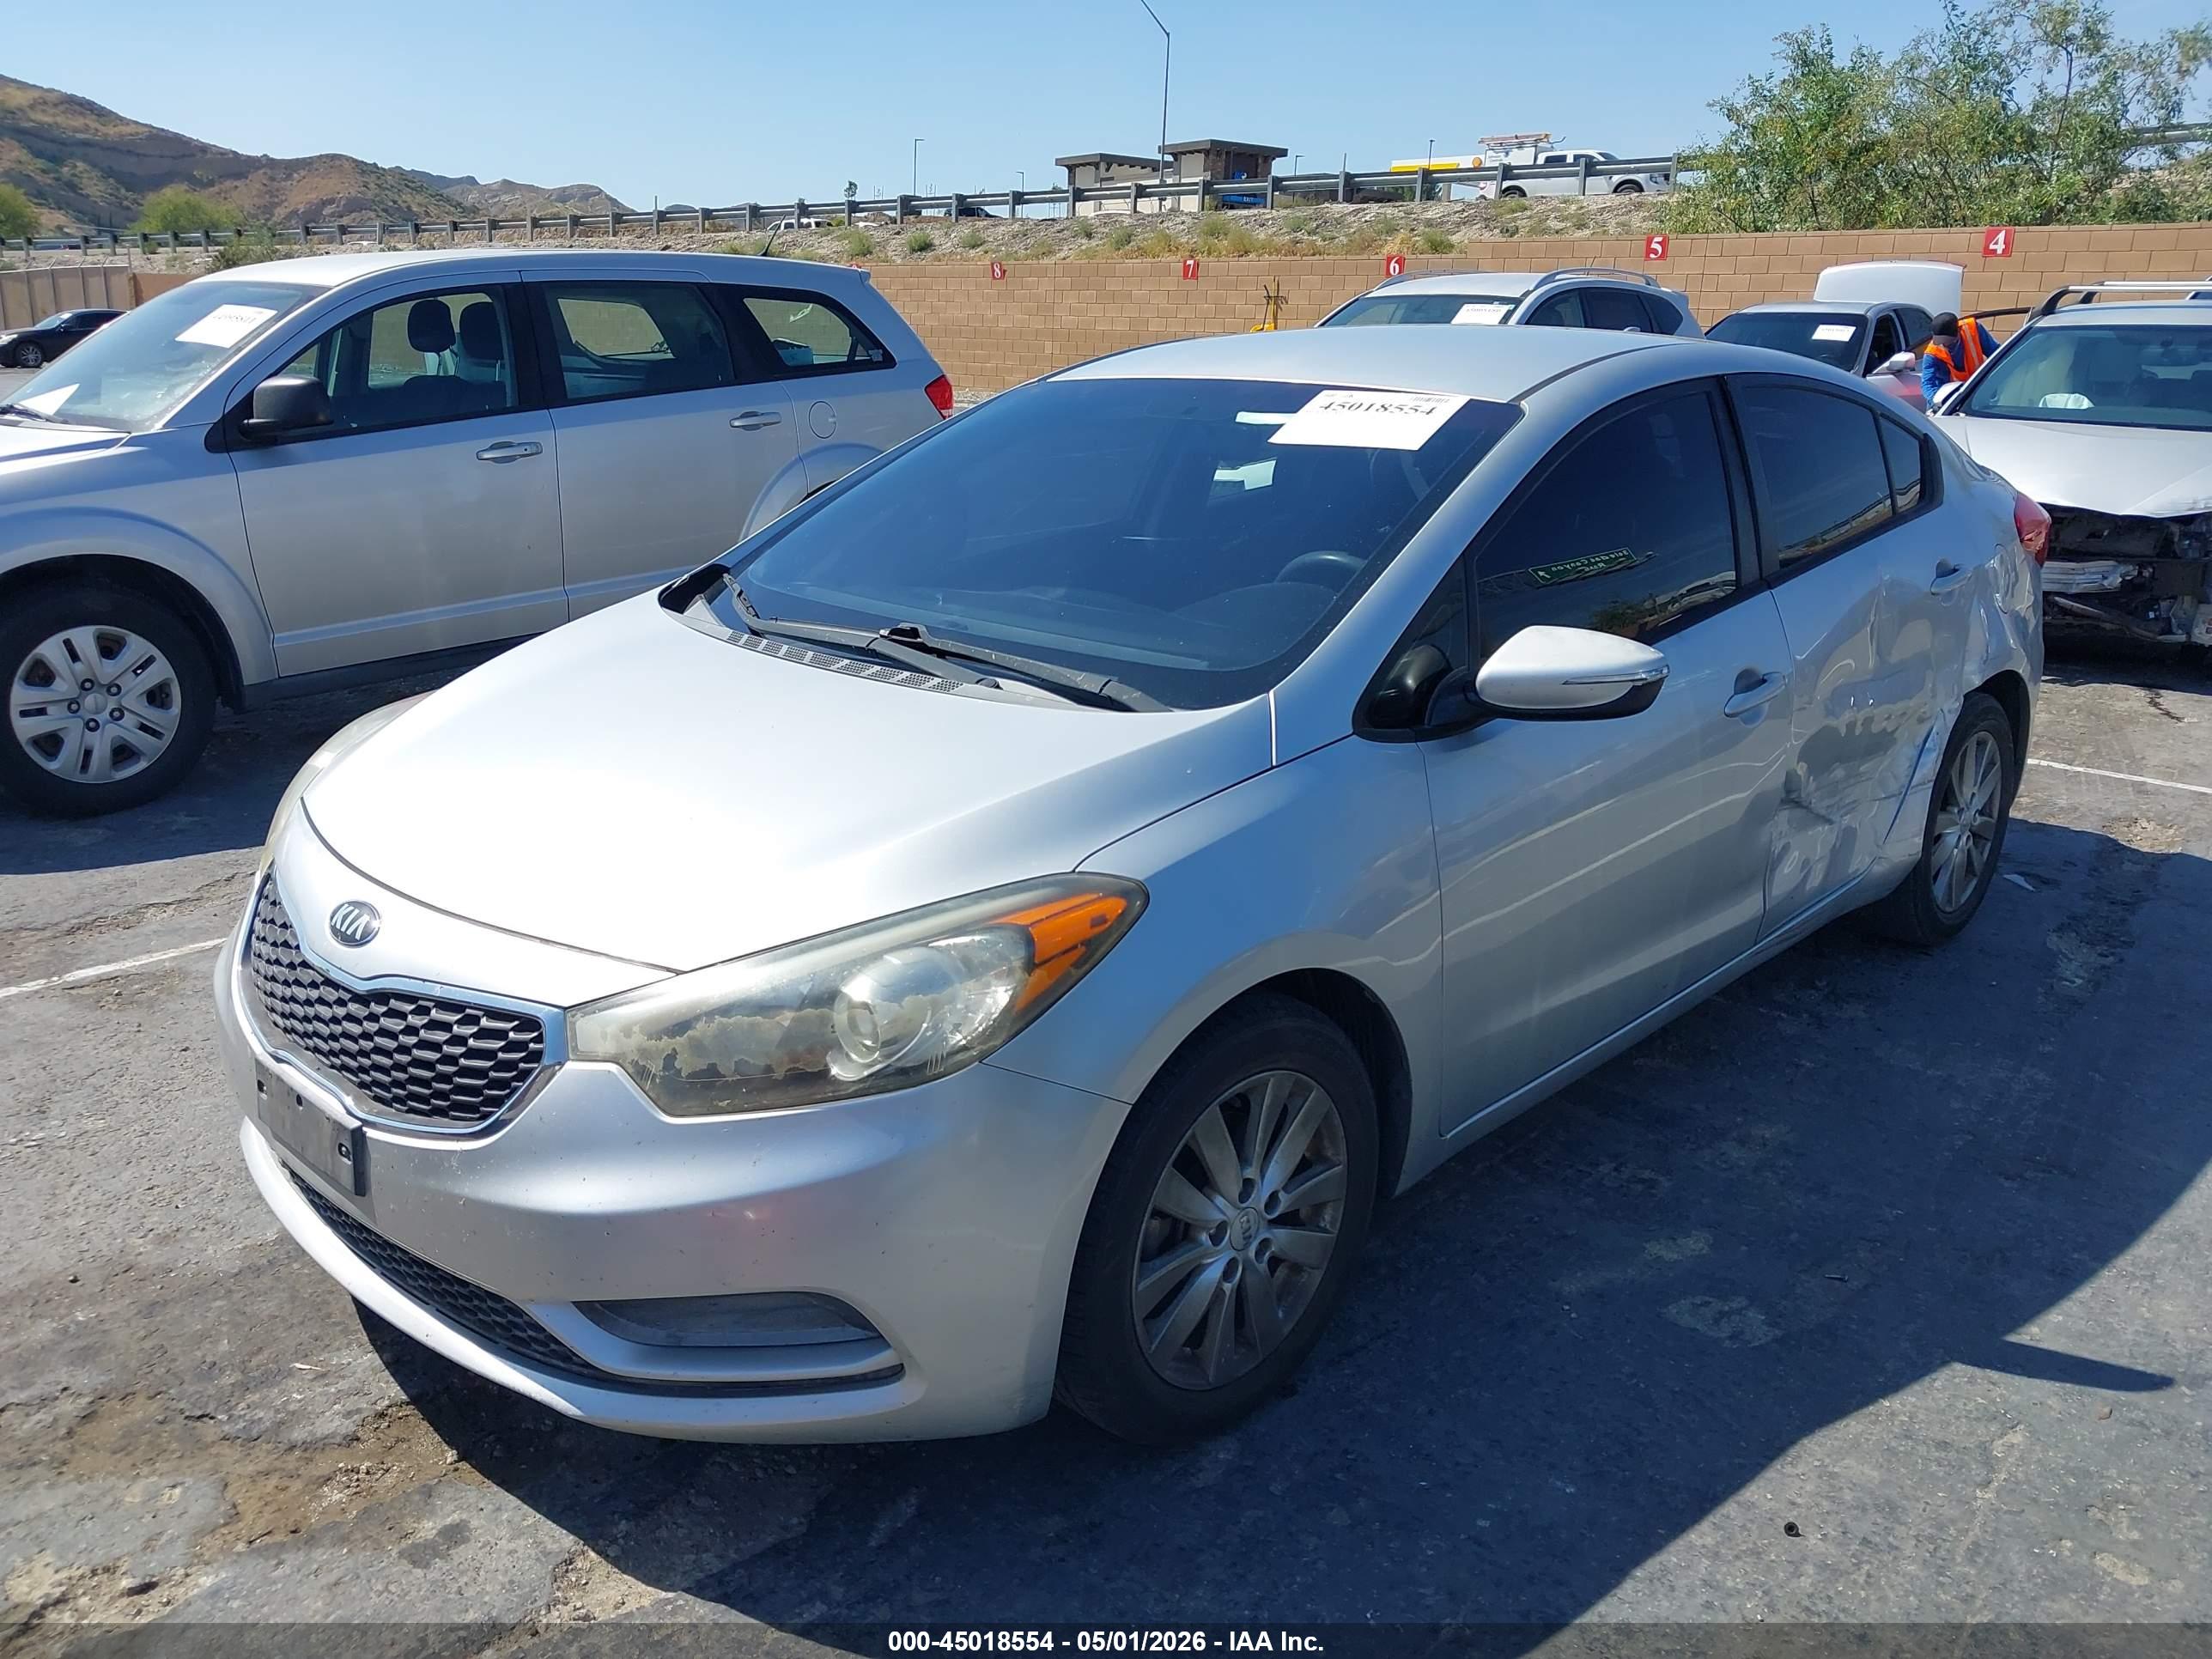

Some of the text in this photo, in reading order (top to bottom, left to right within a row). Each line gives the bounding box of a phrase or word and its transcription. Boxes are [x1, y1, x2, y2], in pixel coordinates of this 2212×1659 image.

[1650, 237, 1662, 258] 5
[1989, 229, 2005, 254] 4
[994, 263, 1000, 278] 8
[1186, 260, 1194, 278] 7
[1390, 257, 1399, 275] 6
[1319, 401, 1437, 416] 45018554
[331, 903, 370, 941] KIA
